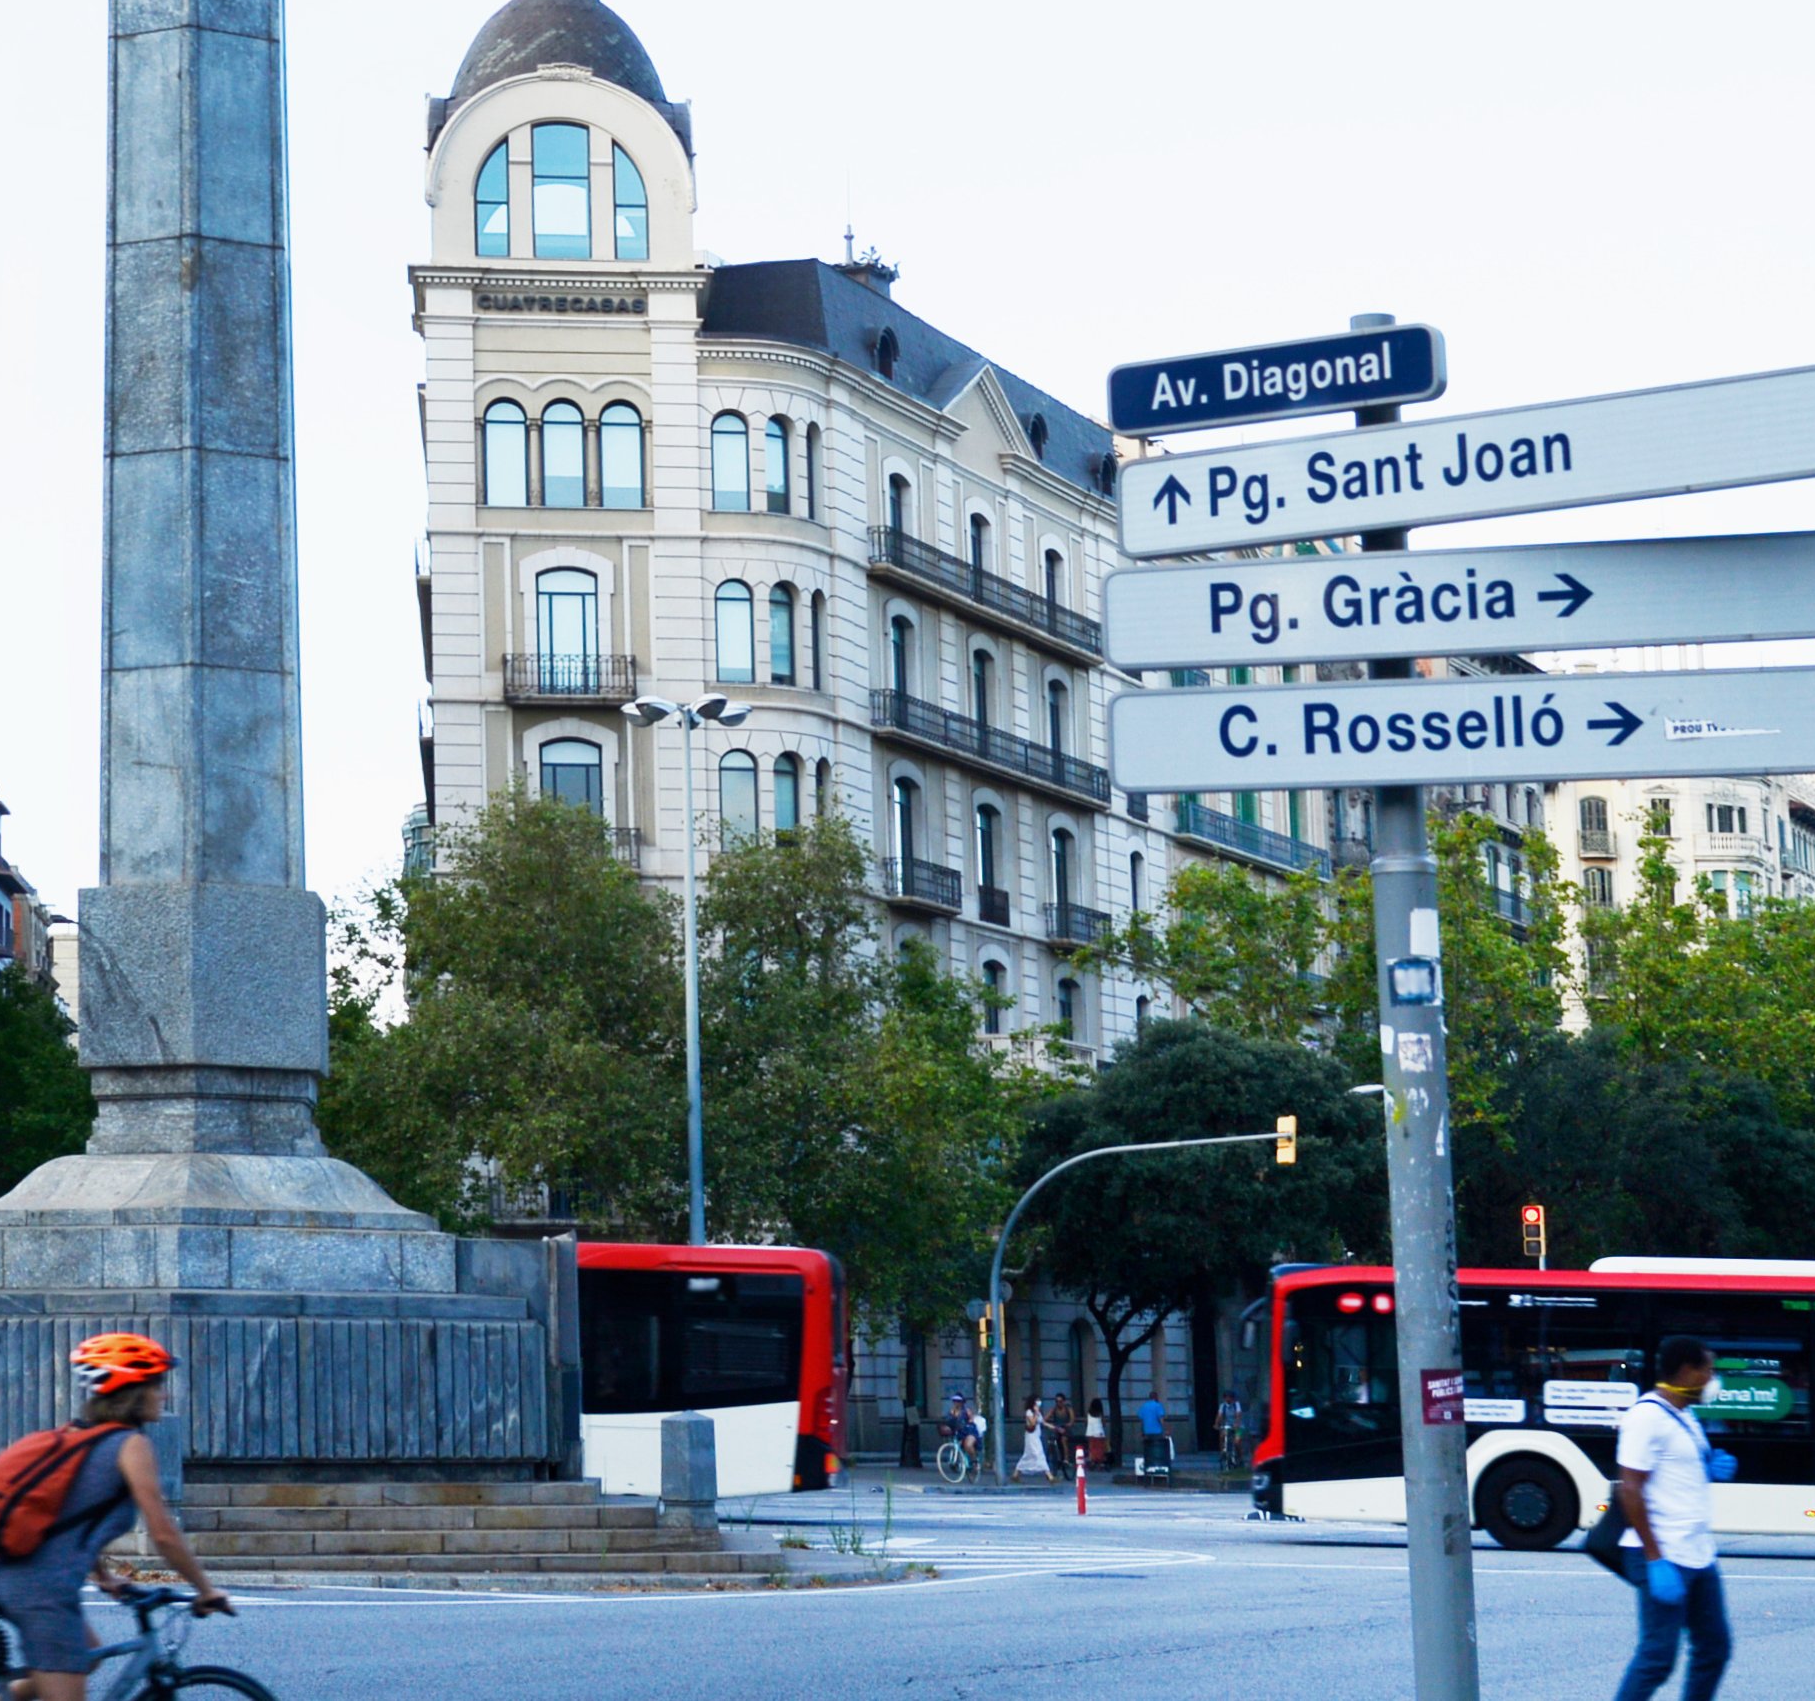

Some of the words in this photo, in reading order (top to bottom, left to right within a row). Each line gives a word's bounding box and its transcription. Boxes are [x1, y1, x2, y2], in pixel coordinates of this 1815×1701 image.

[477, 294, 646, 314] CUATRECASAS
[1151, 372, 1208, 410] Av.
[1223, 341, 1392, 402] Diagonal
[1208, 465, 1286, 525] Pg.
[1307, 442, 1424, 504] Sant
[1442, 432, 1572, 487] Joan
[1209, 582, 1299, 645] Pg.
[1323, 568, 1516, 628] Gràcia
[1219, 704, 1277, 758] C.
[1303, 693, 1564, 755] Rosselló
[1673, 724, 1702, 734] PROU
